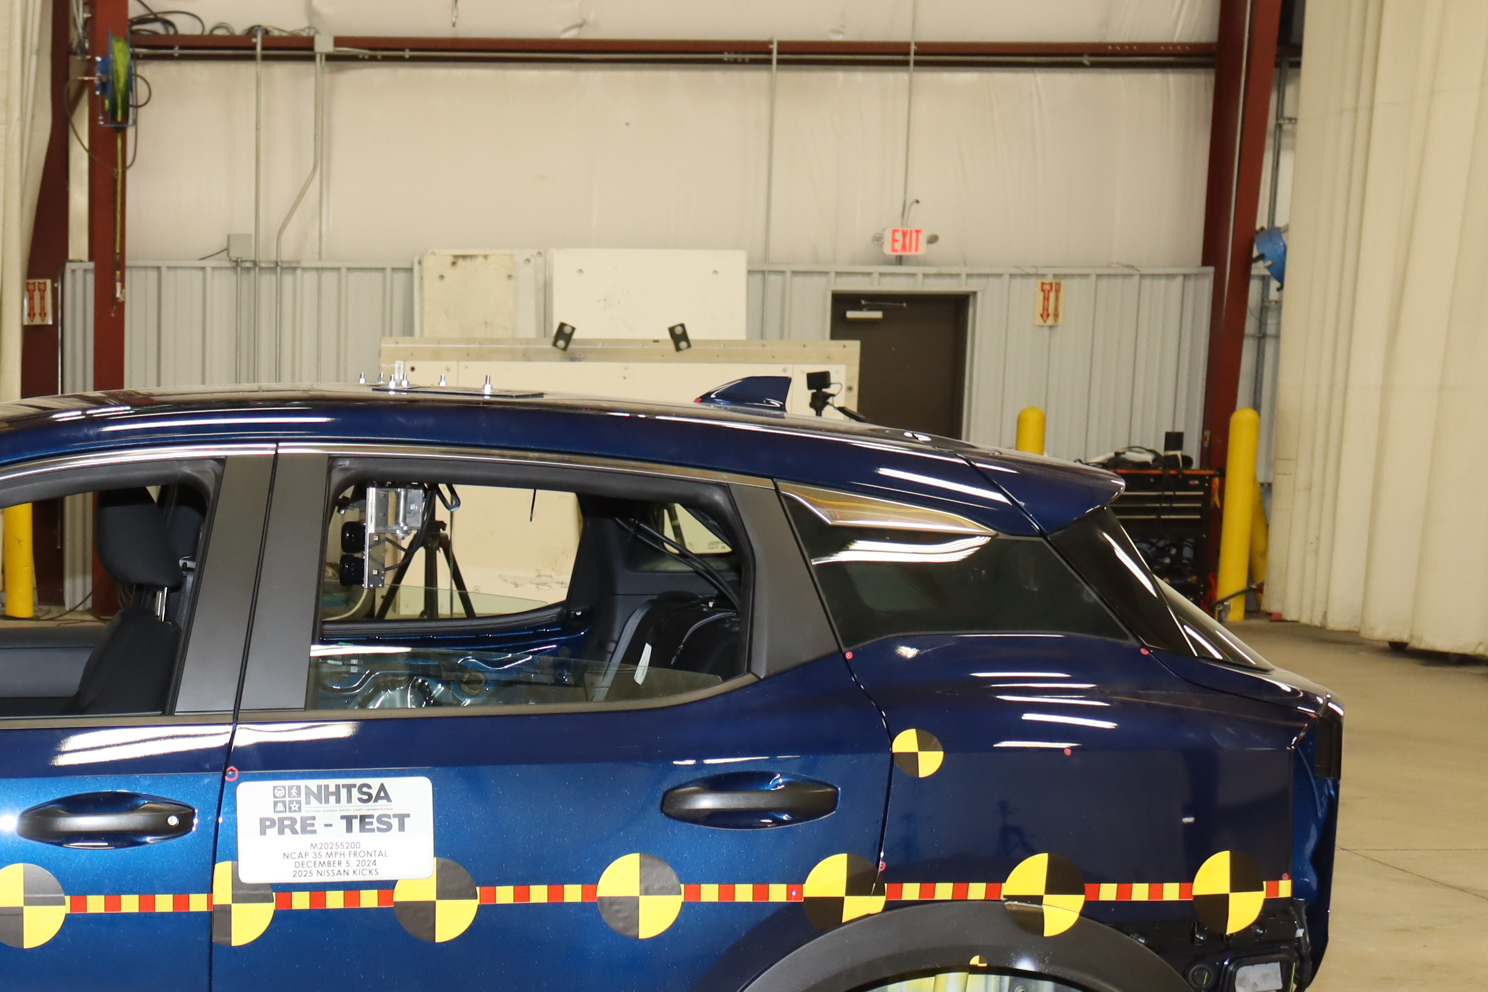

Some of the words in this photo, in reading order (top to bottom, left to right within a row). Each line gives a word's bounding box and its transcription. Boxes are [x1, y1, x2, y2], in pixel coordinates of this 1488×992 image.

[892, 229, 924, 253] EXIT
[305, 783, 392, 805] NHTSA
[259, 816, 316, 836] PRE
[340, 813, 410, 833] TEST
[310, 841, 361, 850] M20255200
[283, 852, 309, 860] NCAP
[312, 852, 323, 860] 35
[326, 851, 345, 859] MPH
[349, 850, 388, 858] FRONTAL
[294, 861, 342, 869] DECEMBER
[345, 861, 353, 869] 5,
[292, 870, 314, 878] 2025
[316, 869, 349, 877] NISSAN
[353, 868, 379, 876] KICKS
